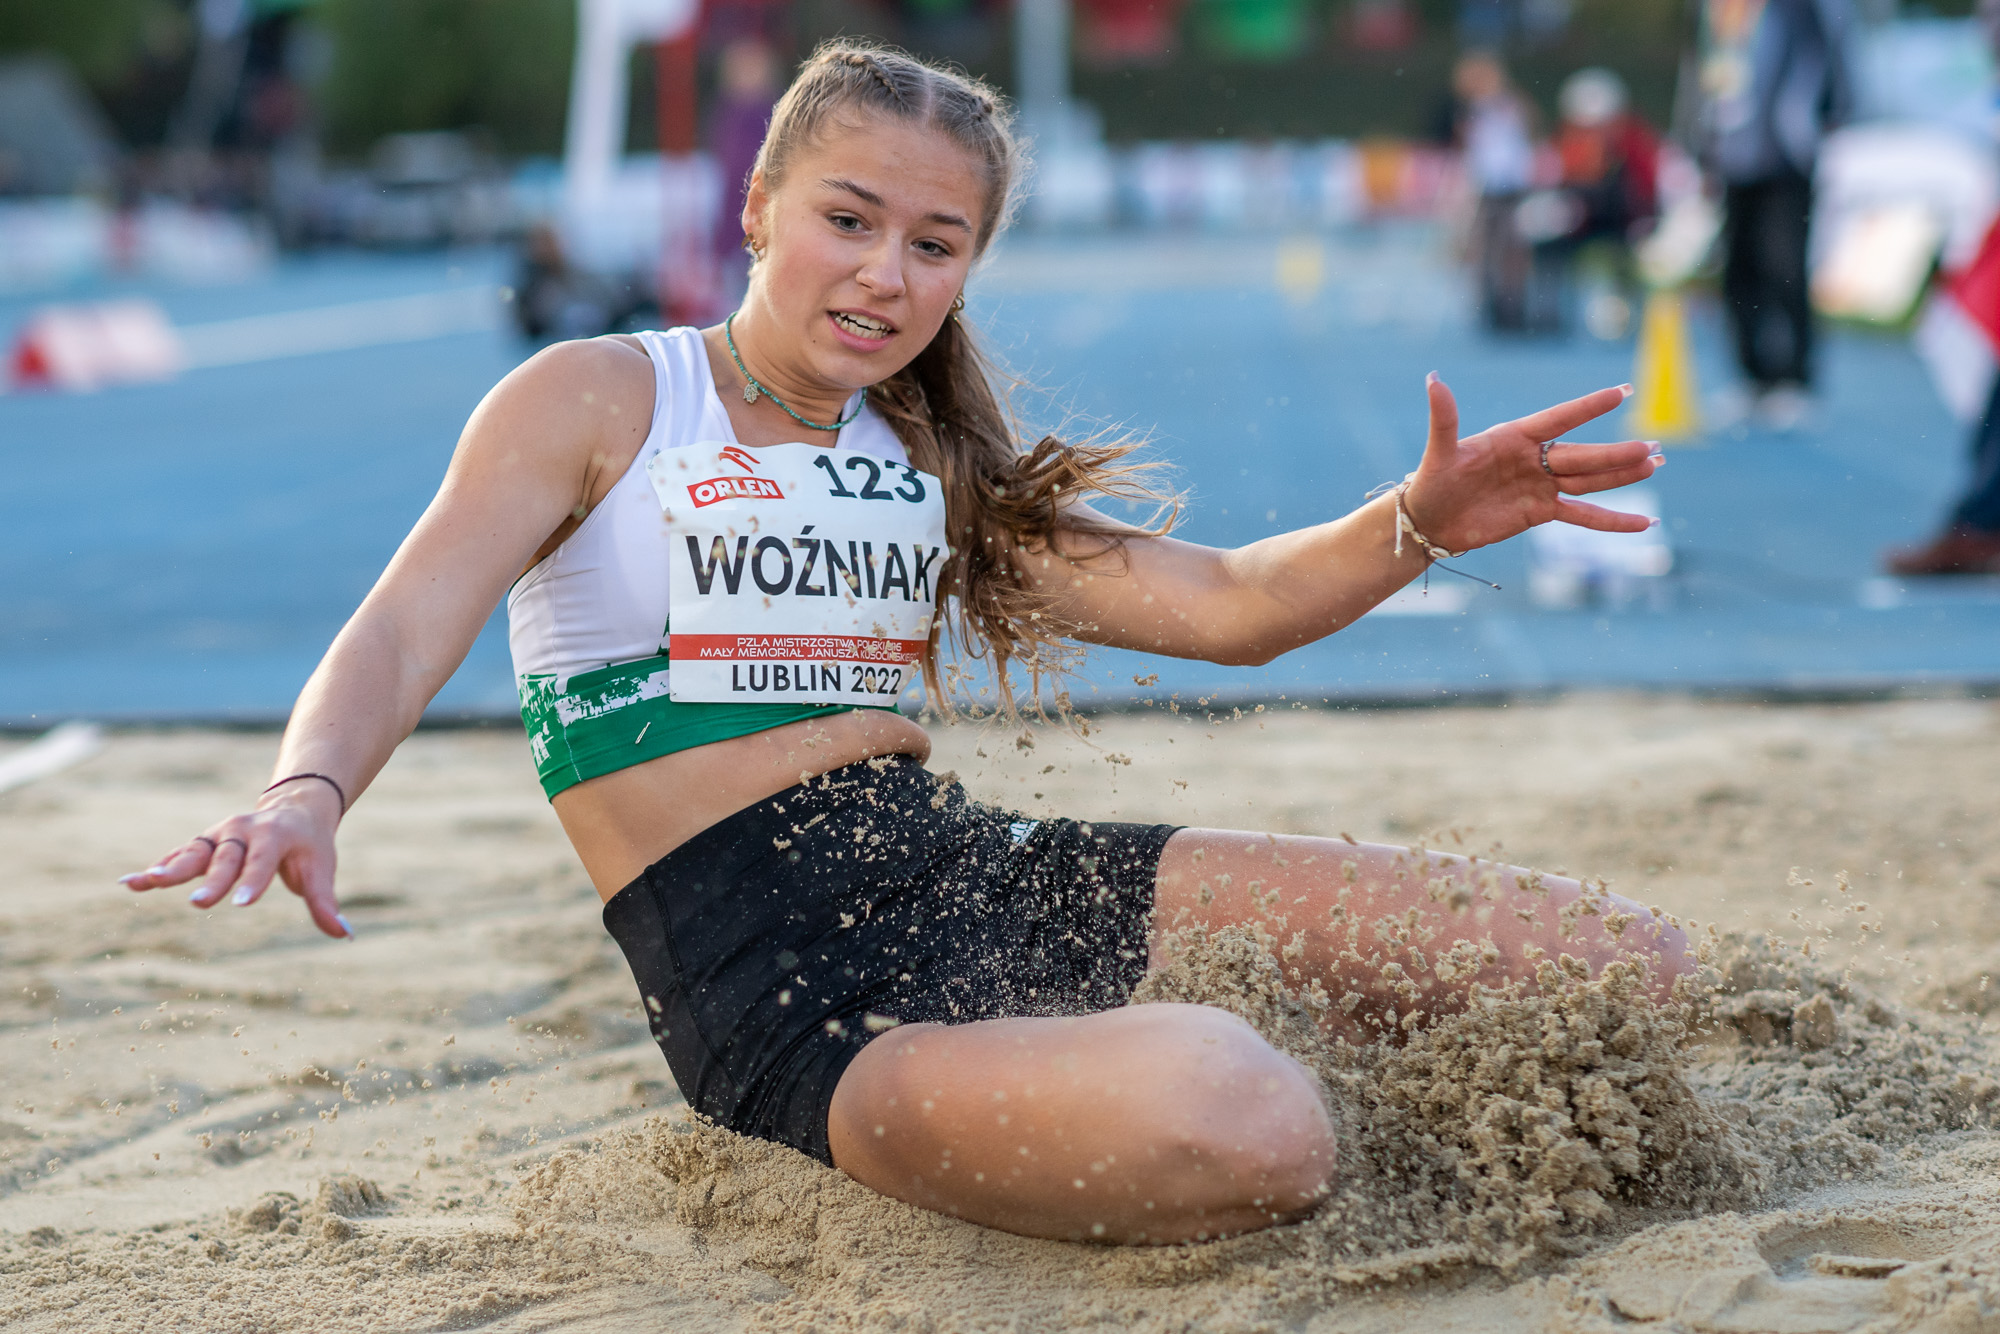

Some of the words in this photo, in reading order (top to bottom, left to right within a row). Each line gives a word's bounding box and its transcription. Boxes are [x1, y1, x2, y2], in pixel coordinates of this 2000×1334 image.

[694, 479, 779, 504] ORLEN
[813, 454, 926, 503] 123
[685, 525, 940, 603] WOŹNIAK
[700, 647, 735, 657] MAŁY
[737, 647, 804, 658] MEMORIAŁ
[807, 648, 860, 659] JANUSZA
[737, 637, 770, 647] PZLA
[772, 637, 855, 648] MISTRZOSTWA
[732, 664, 841, 692] LUBLIN
[850, 665, 902, 695] 2022
